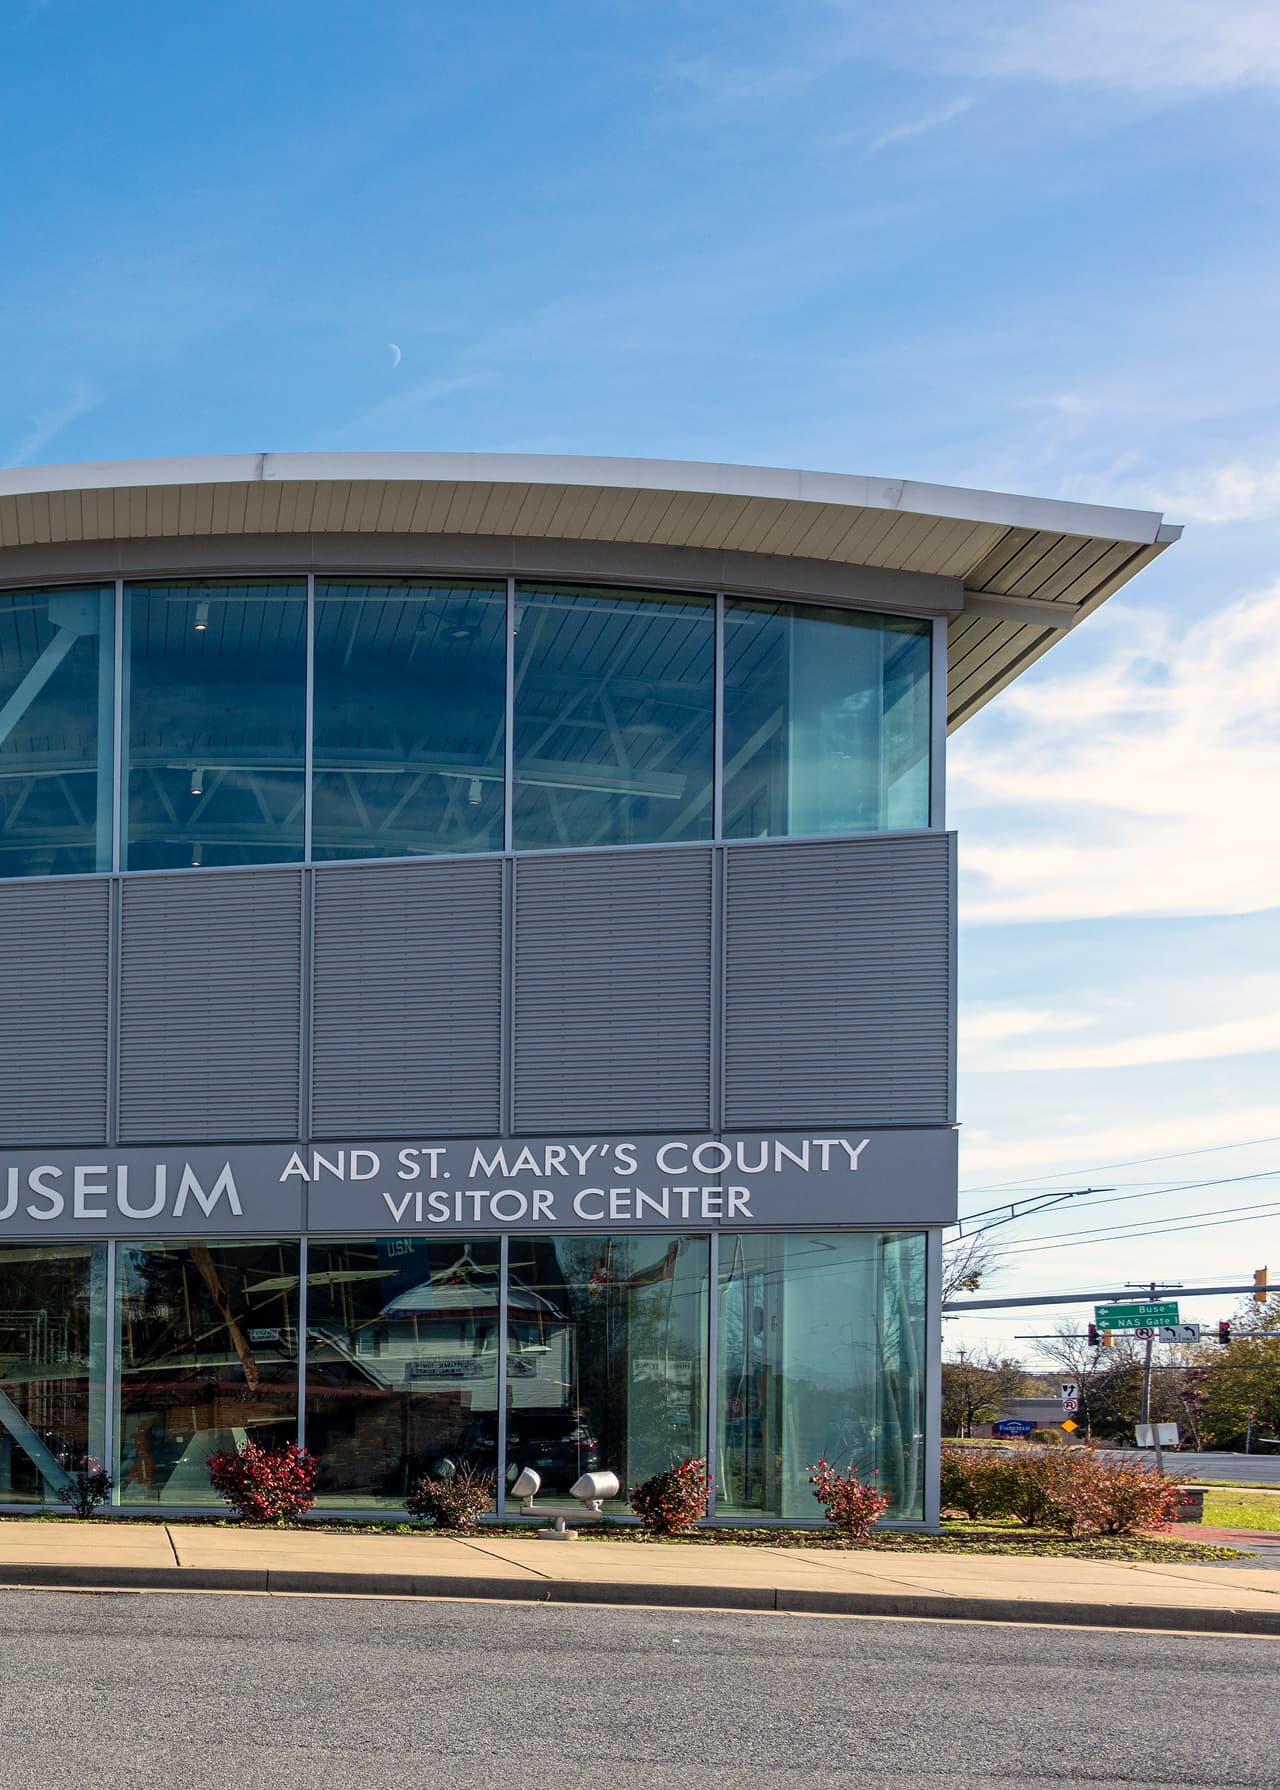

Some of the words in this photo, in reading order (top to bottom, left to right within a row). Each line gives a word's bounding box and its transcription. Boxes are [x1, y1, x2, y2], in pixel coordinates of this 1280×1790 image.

[280, 1150, 380, 1182] AND
[397, 1148, 451, 1180] ST.
[468, 1143, 638, 1178] MARY'S
[656, 1138, 871, 1175] COUNTY
[382, 1189, 558, 1223] VISITOR
[573, 1186, 754, 1220] CENTER
[1138, 1305, 1165, 1313] Buse
[1118, 1318, 1141, 1327] NAS
[1146, 1316, 1170, 1326] Gate
